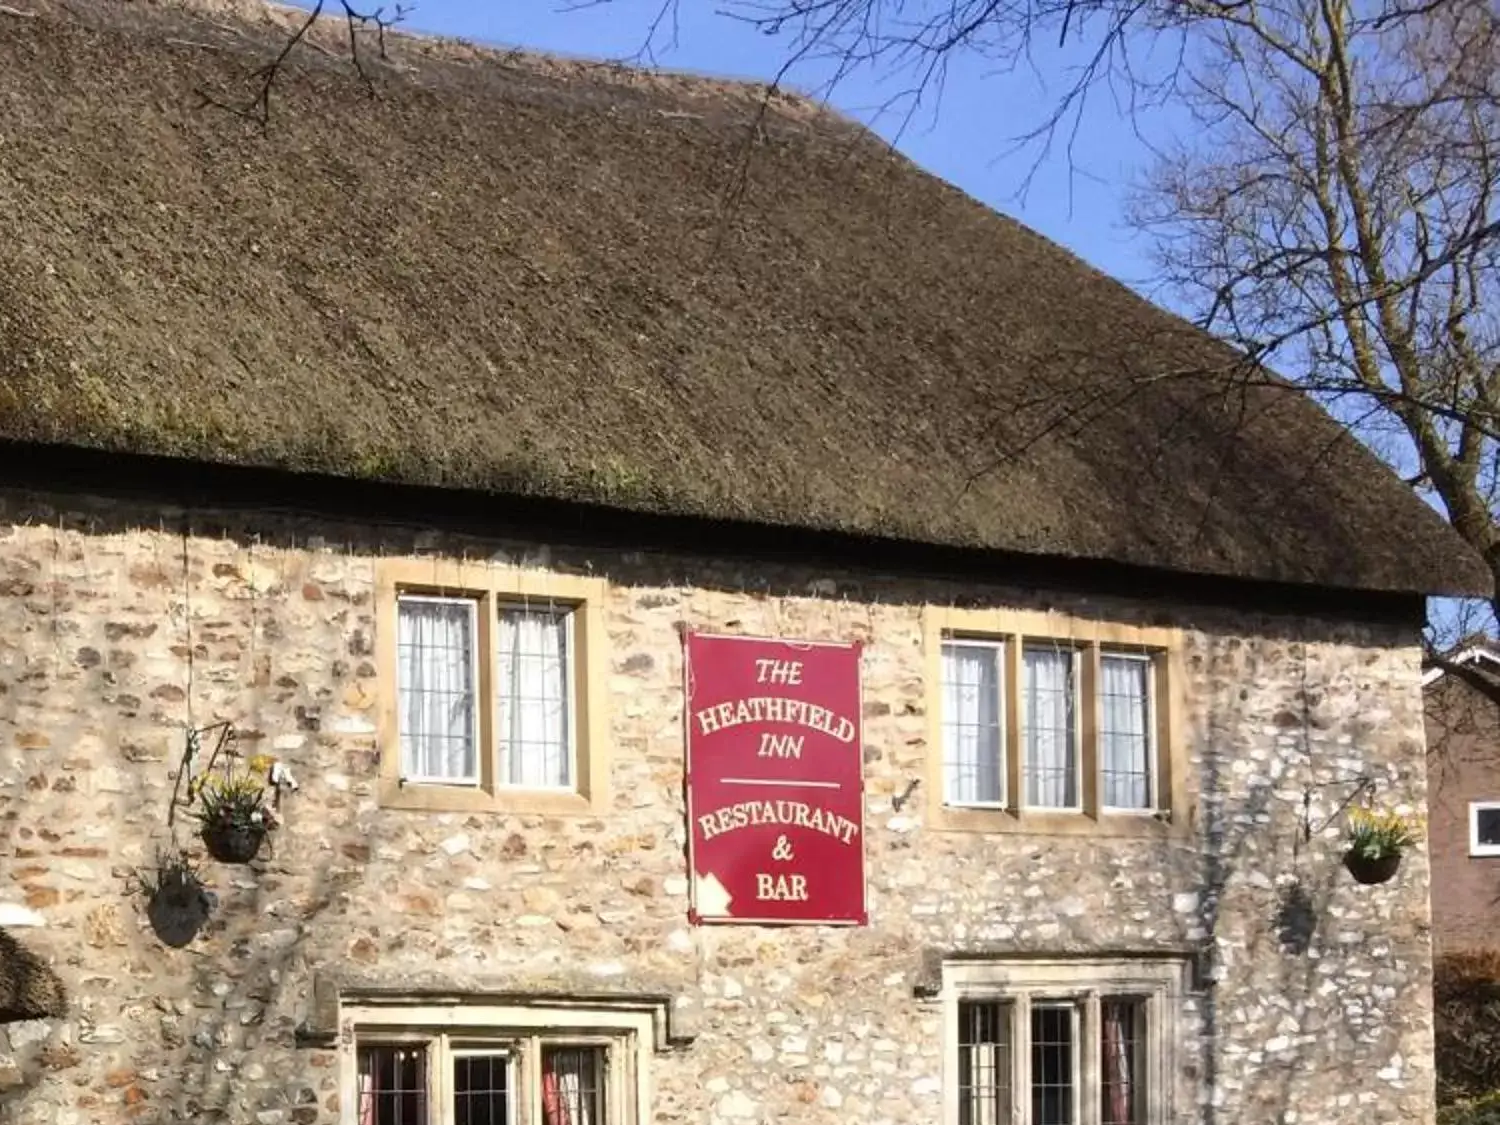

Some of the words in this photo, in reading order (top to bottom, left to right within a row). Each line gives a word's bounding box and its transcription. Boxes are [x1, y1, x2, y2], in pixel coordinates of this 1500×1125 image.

[755, 659, 804, 685] THE
[695, 697, 856, 744] HEATHFIELD
[757, 733, 805, 759] INN
[698, 800, 860, 846] RESTAURANT
[771, 835, 794, 861] &
[756, 873, 809, 901] BAR
